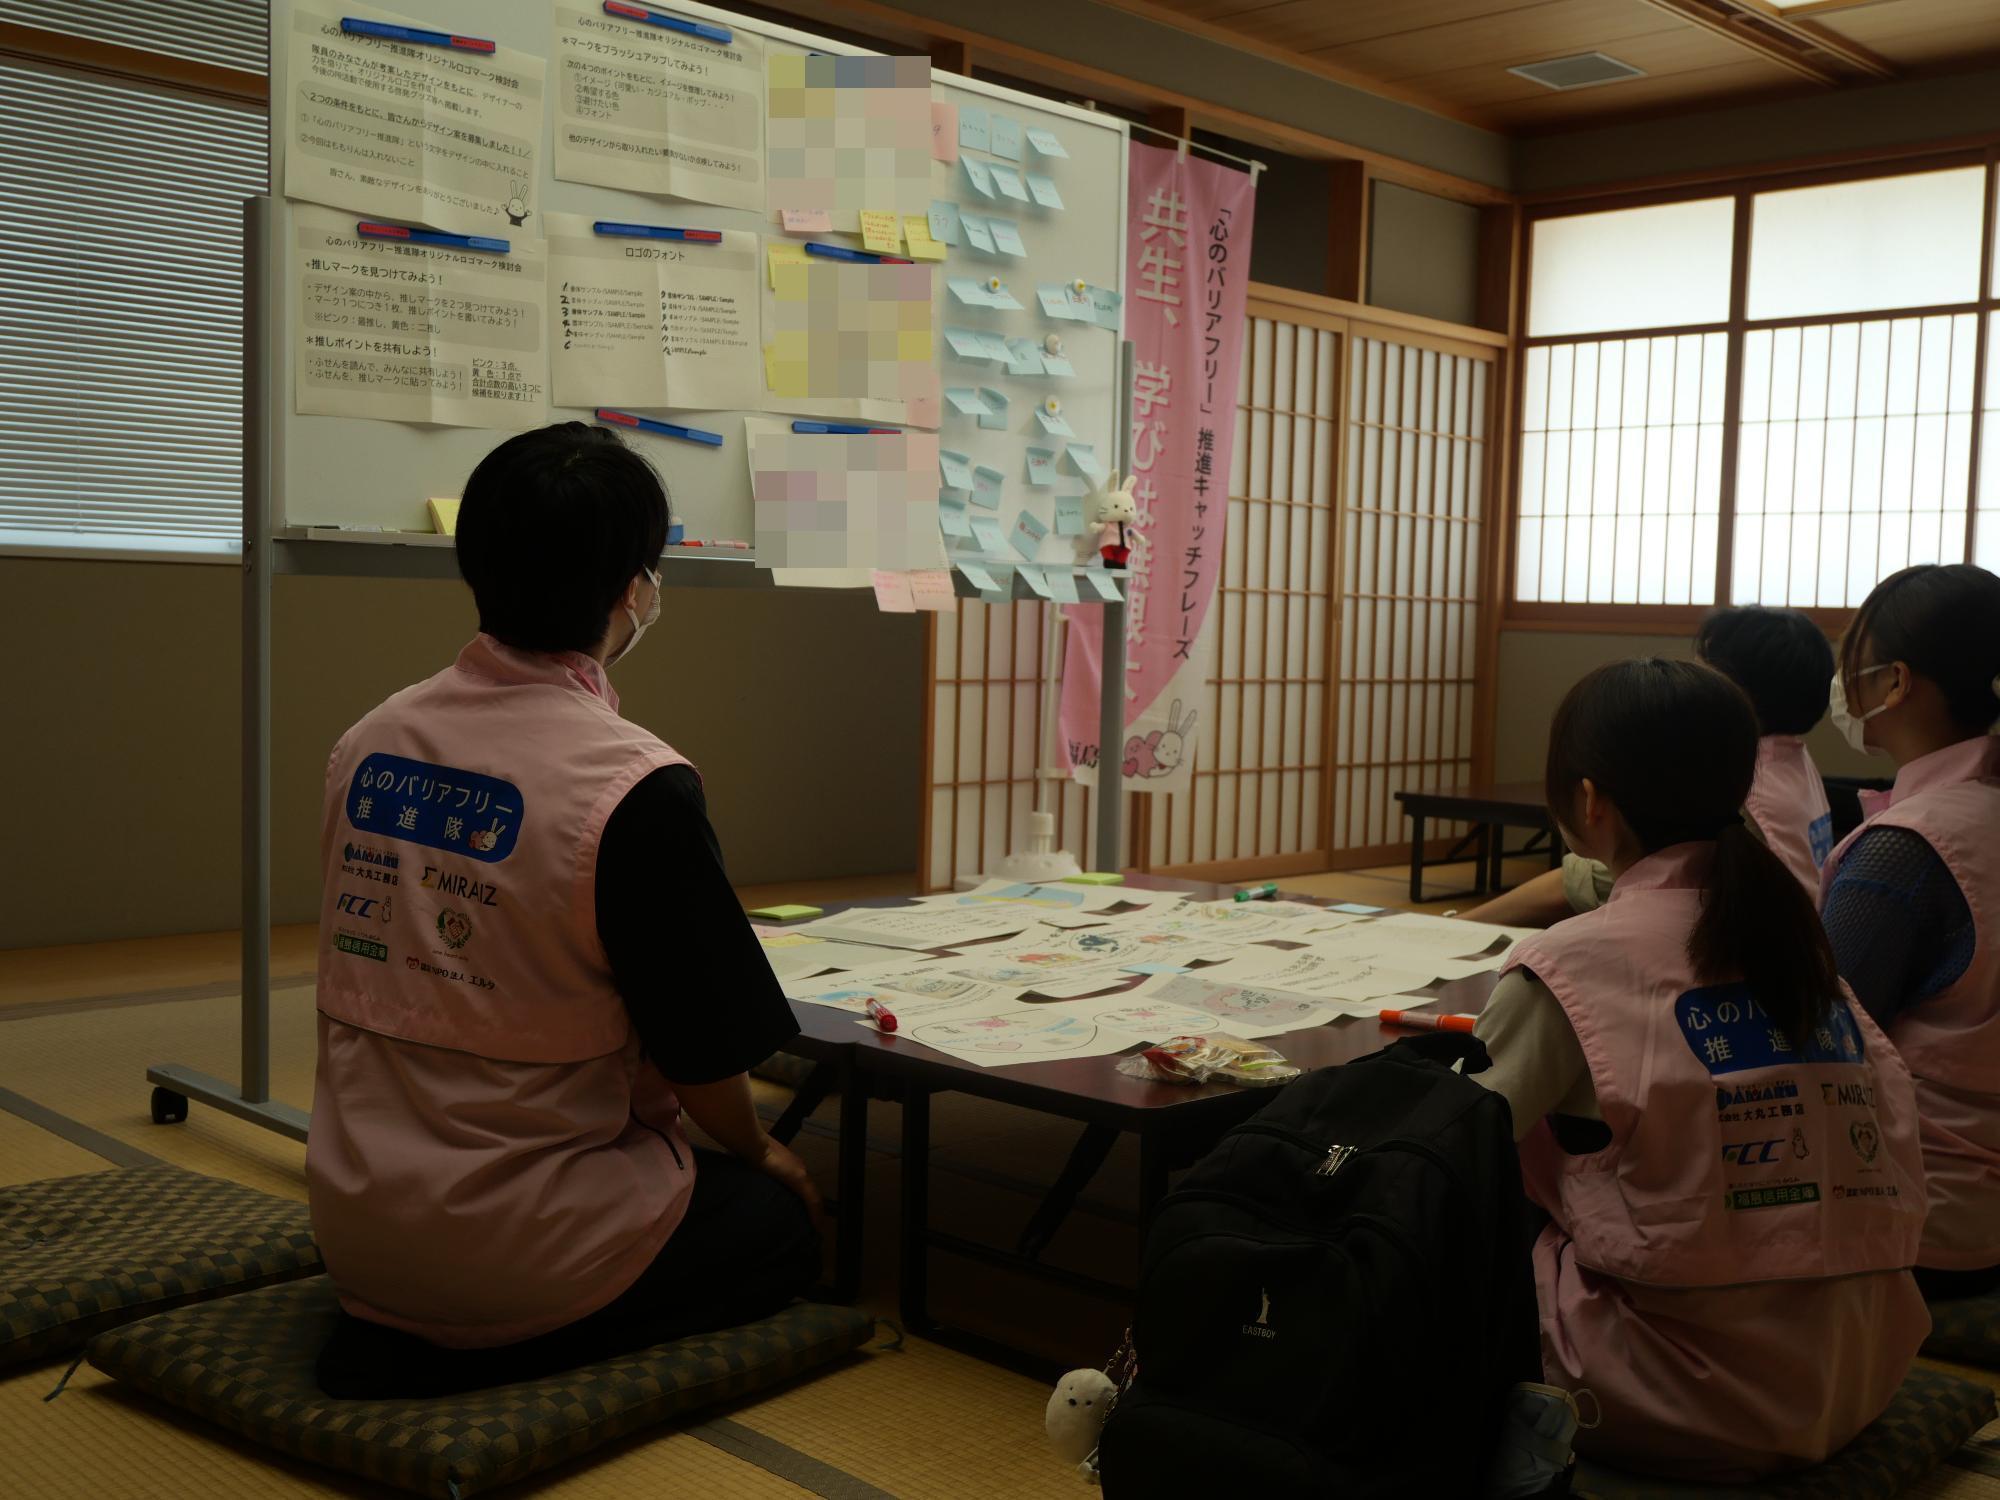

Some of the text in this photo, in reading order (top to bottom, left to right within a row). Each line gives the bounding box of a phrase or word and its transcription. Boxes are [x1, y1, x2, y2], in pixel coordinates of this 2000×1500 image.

[625, 247, 686, 261] ロゴのフォント
[360, 766, 513, 815] 心のバリアフリー
[437, 875, 498, 906] MIRAIZ
[336, 893, 379, 919] FCC
[1722, 1139, 1785, 1166] FCC
[1242, 1324, 1276, 1339] EASTBOY
